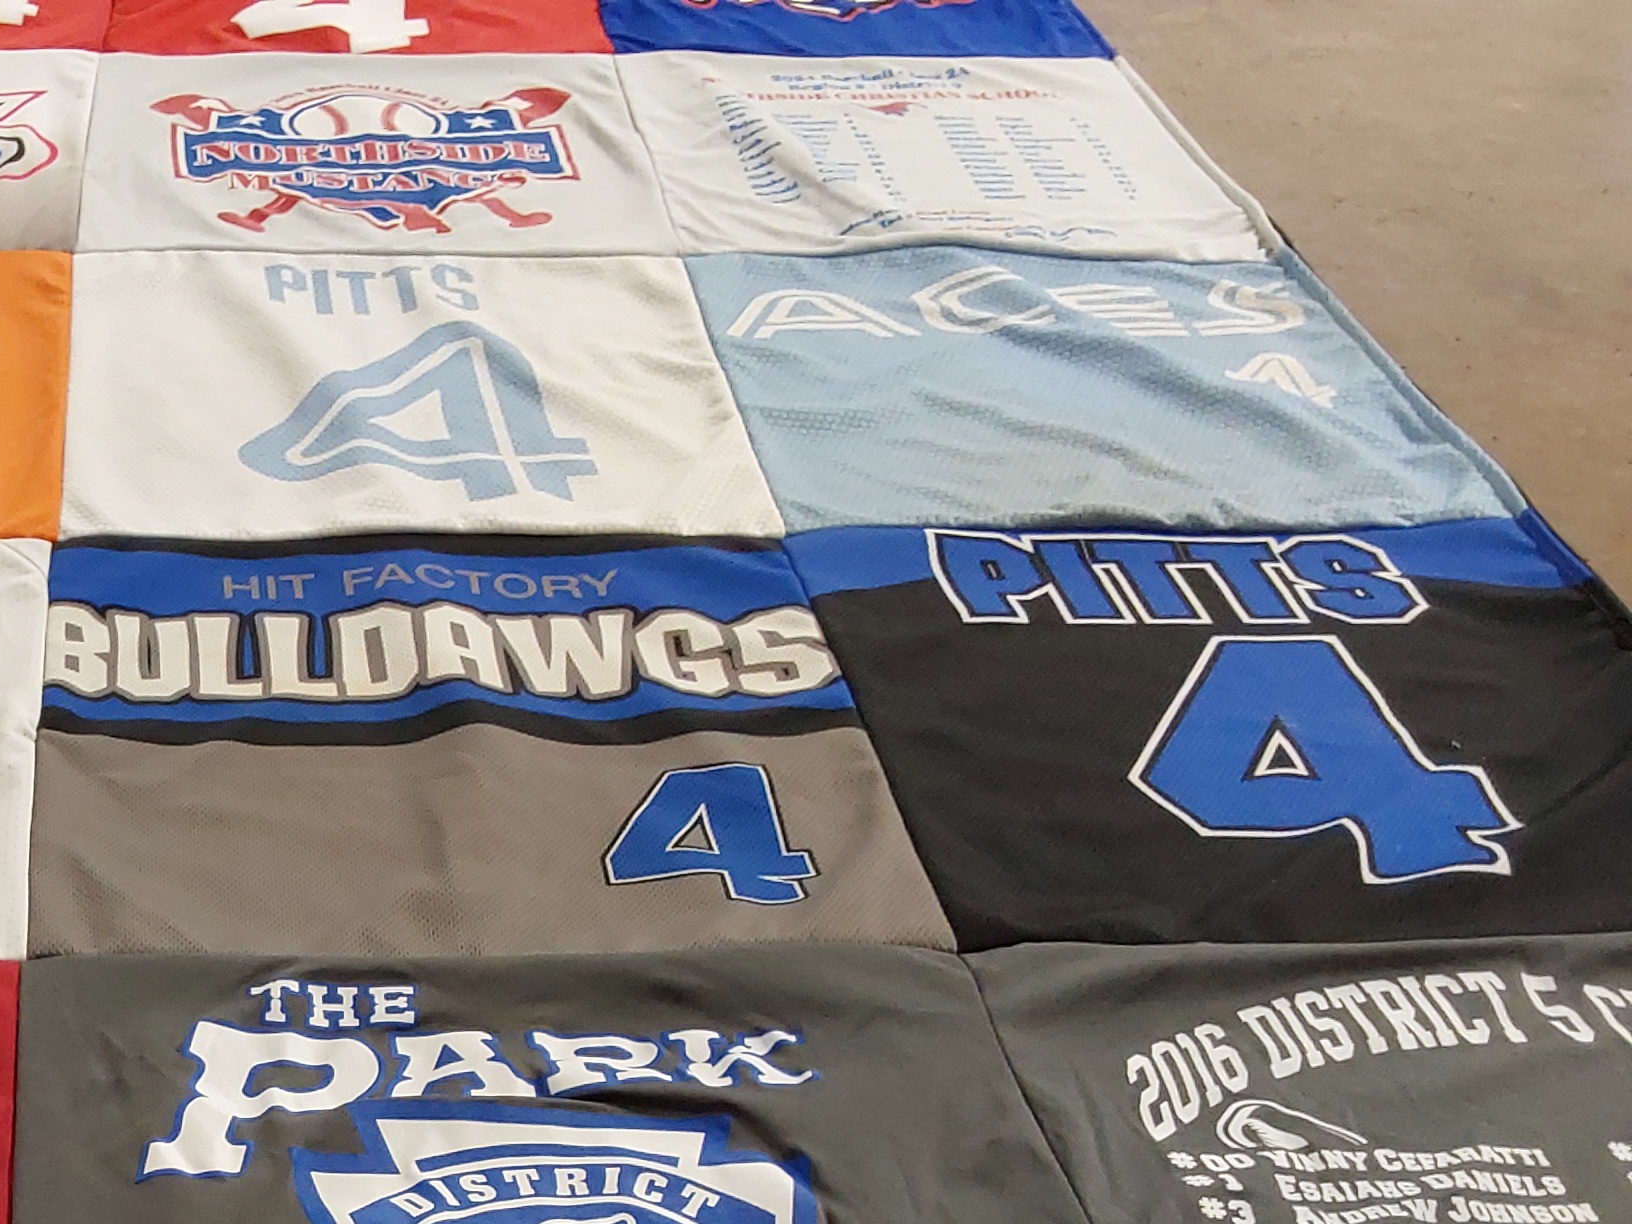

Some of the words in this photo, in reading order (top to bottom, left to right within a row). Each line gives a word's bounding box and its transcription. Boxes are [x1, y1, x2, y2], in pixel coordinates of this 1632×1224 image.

[191, 141, 552, 166] NORTHSIDE
[227, 169, 528, 192] MUSTANGS
[265, 264, 478, 315] PITTS
[726, 266, 1306, 338] ACES
[236, 320, 599, 502] 4
[222, 572, 314, 600] HIT
[344, 562, 620, 600] FACTORY
[925, 528, 1430, 626] PITTS
[48, 603, 842, 702] BULLDAWGS
[1127, 634, 1526, 885] 4
[601, 761, 821, 905] 4
[250, 979, 418, 1027] THE
[1126, 1022, 1248, 1142] 2016
[1236, 971, 1528, 1080] DISTRICT
[1520, 971, 1595, 1044] 5
[140, 1020, 820, 1178] PARK
[1256, 1149, 1368, 1173] VINNY
[1373, 1144, 1552, 1173] CEFARATTI
[1419, 1169, 1567, 1197] DANIELS
[388, 1165, 722, 1218] DISTRICT
[1447, 1195, 1600, 1224] JOHNSON
